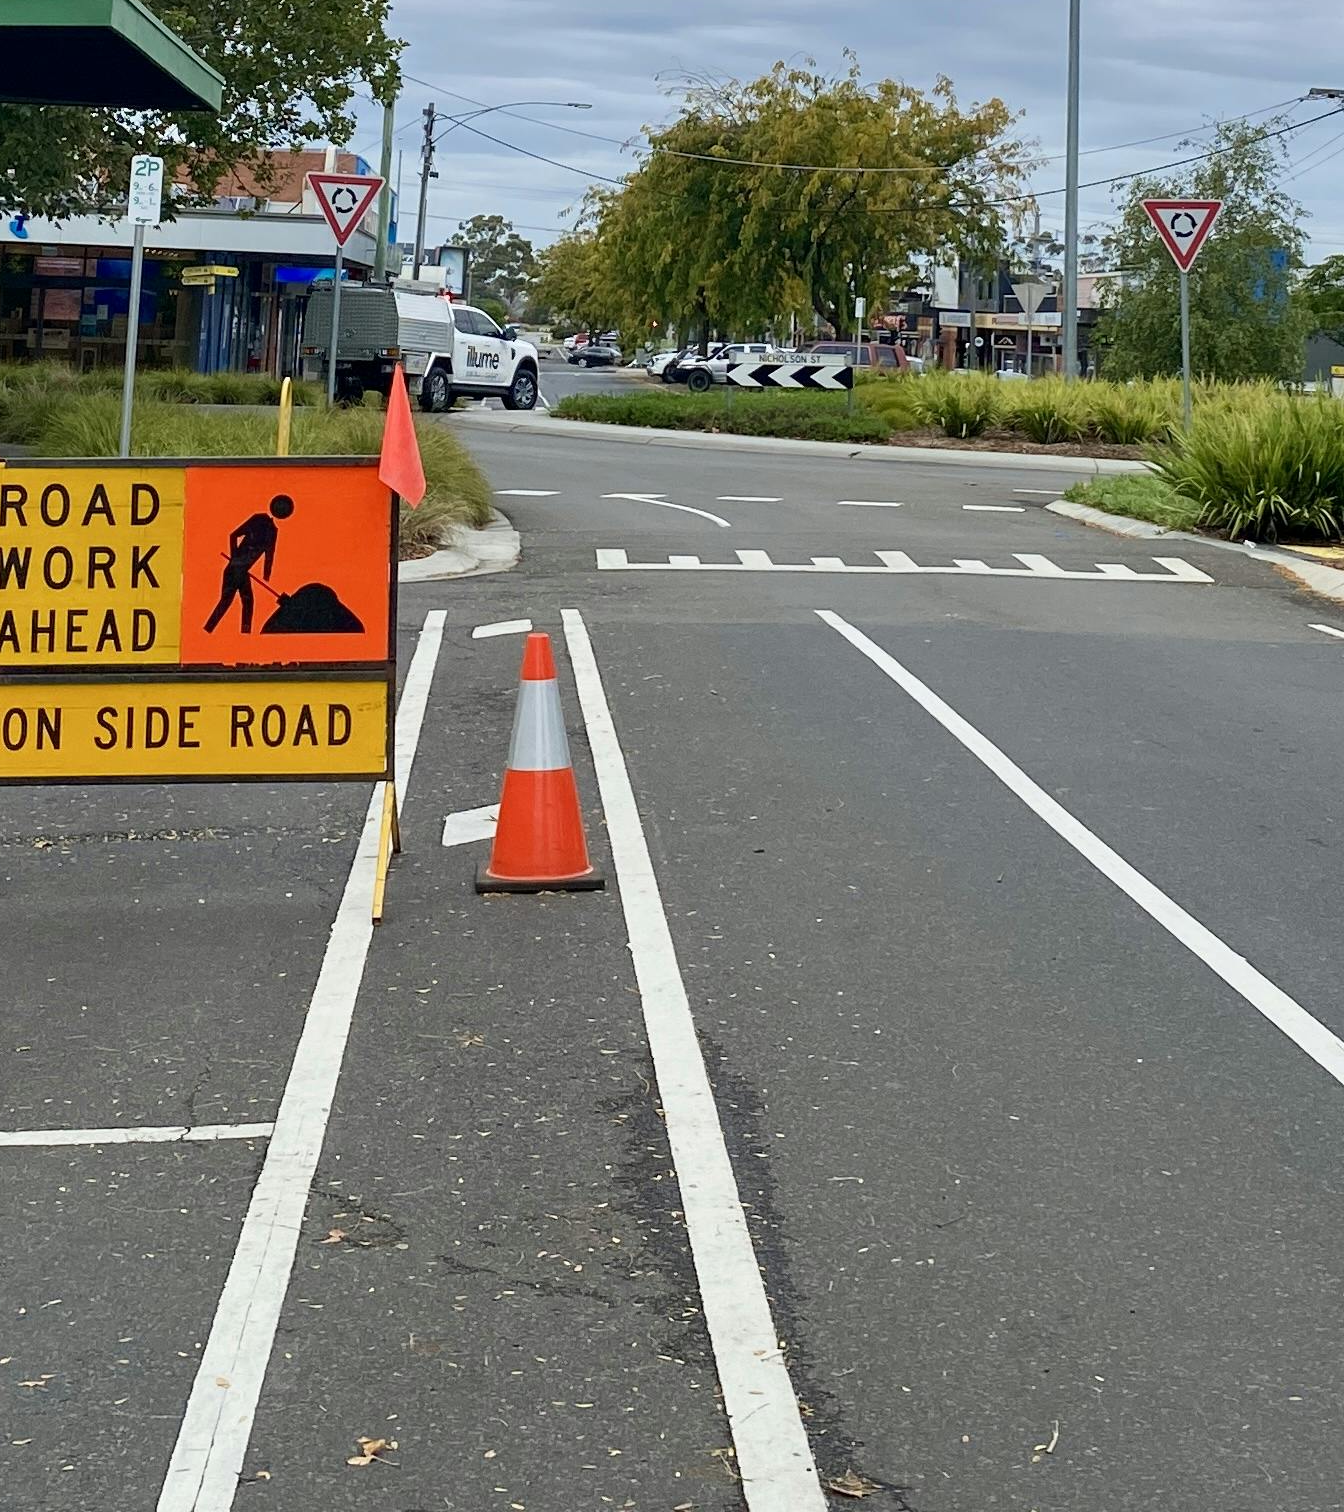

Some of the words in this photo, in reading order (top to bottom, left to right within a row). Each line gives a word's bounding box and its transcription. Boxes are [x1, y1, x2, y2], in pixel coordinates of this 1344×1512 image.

[135, 160, 160, 177] 2P
[466, 345, 500, 370] illume
[759, 354, 808, 364] NICHOLSON
[810, 355, 821, 364] ST
[0, 483, 160, 527] ROAD
[2, 707, 62, 751] ON
[93, 705, 201, 749] SIDE
[230, 703, 352, 748] ROAD
